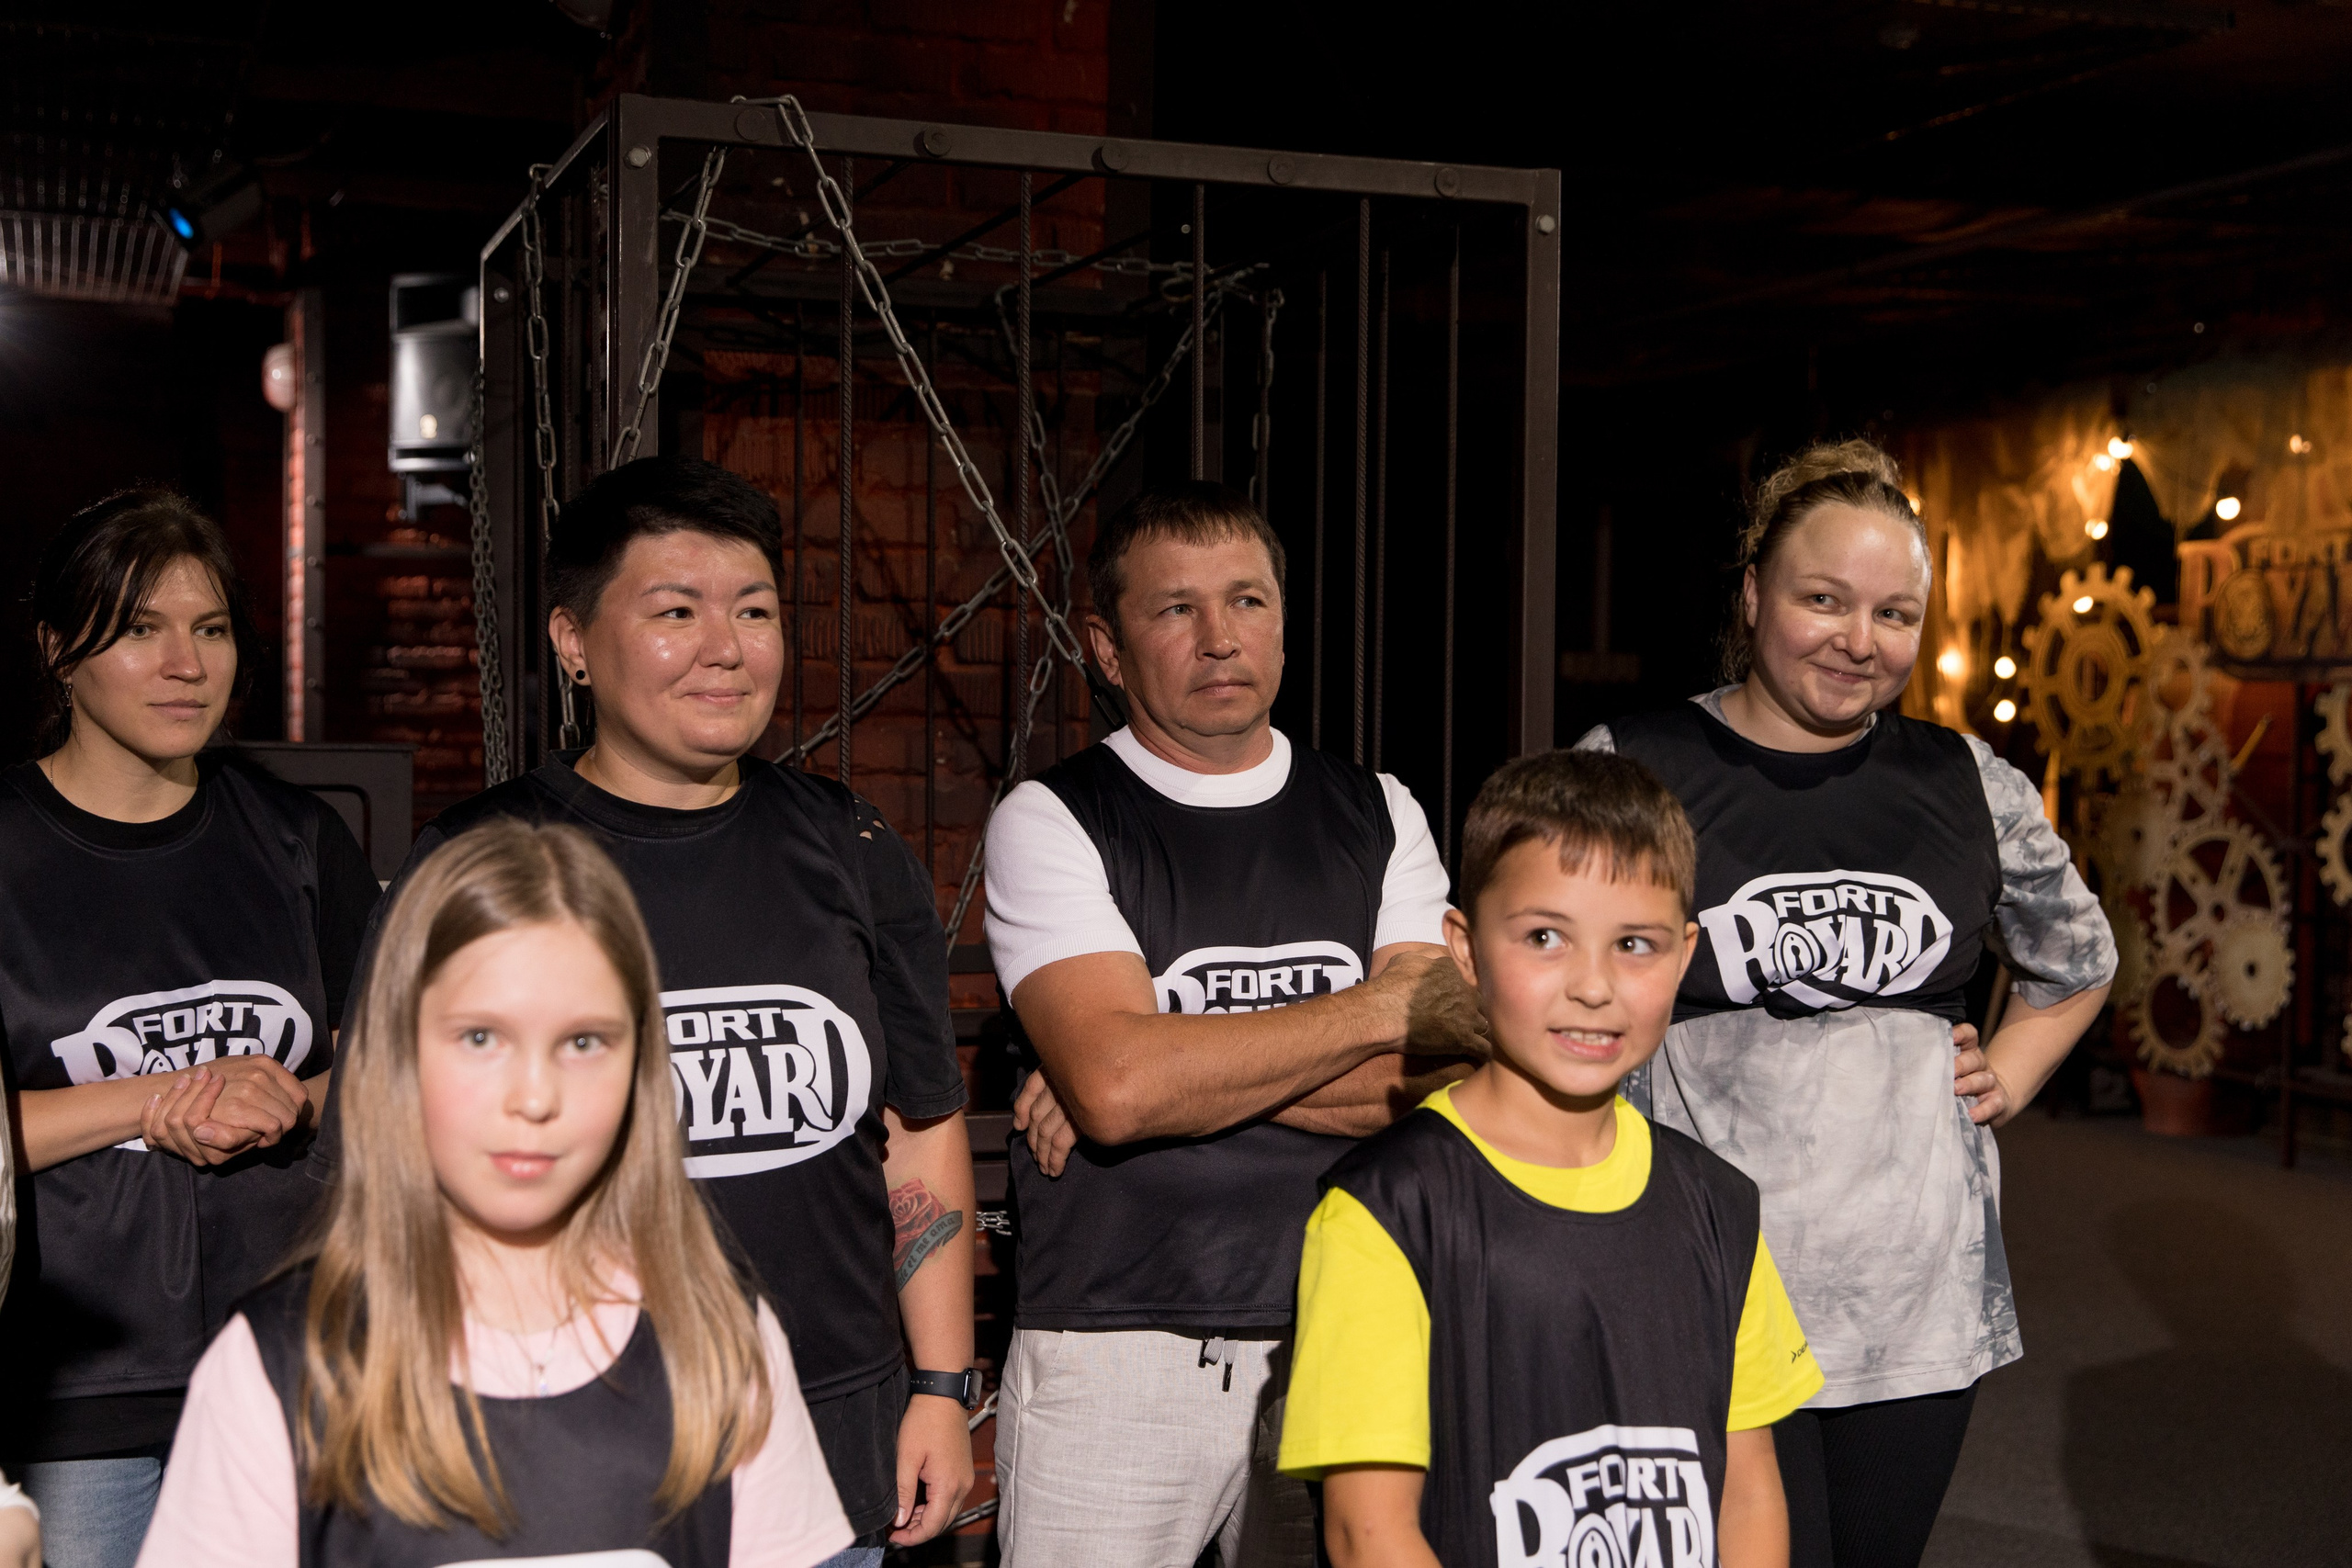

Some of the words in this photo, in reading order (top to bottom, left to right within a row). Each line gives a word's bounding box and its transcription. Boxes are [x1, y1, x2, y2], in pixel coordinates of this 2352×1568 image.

[1772, 885, 1894, 919] FORT
[1205, 964, 1322, 1000] FORT
[132, 1001, 253, 1045] FORT
[662, 1008, 782, 1045] ORT
[668, 1009, 871, 1144] YARD
[1566, 1453, 1679, 1510] FORT
